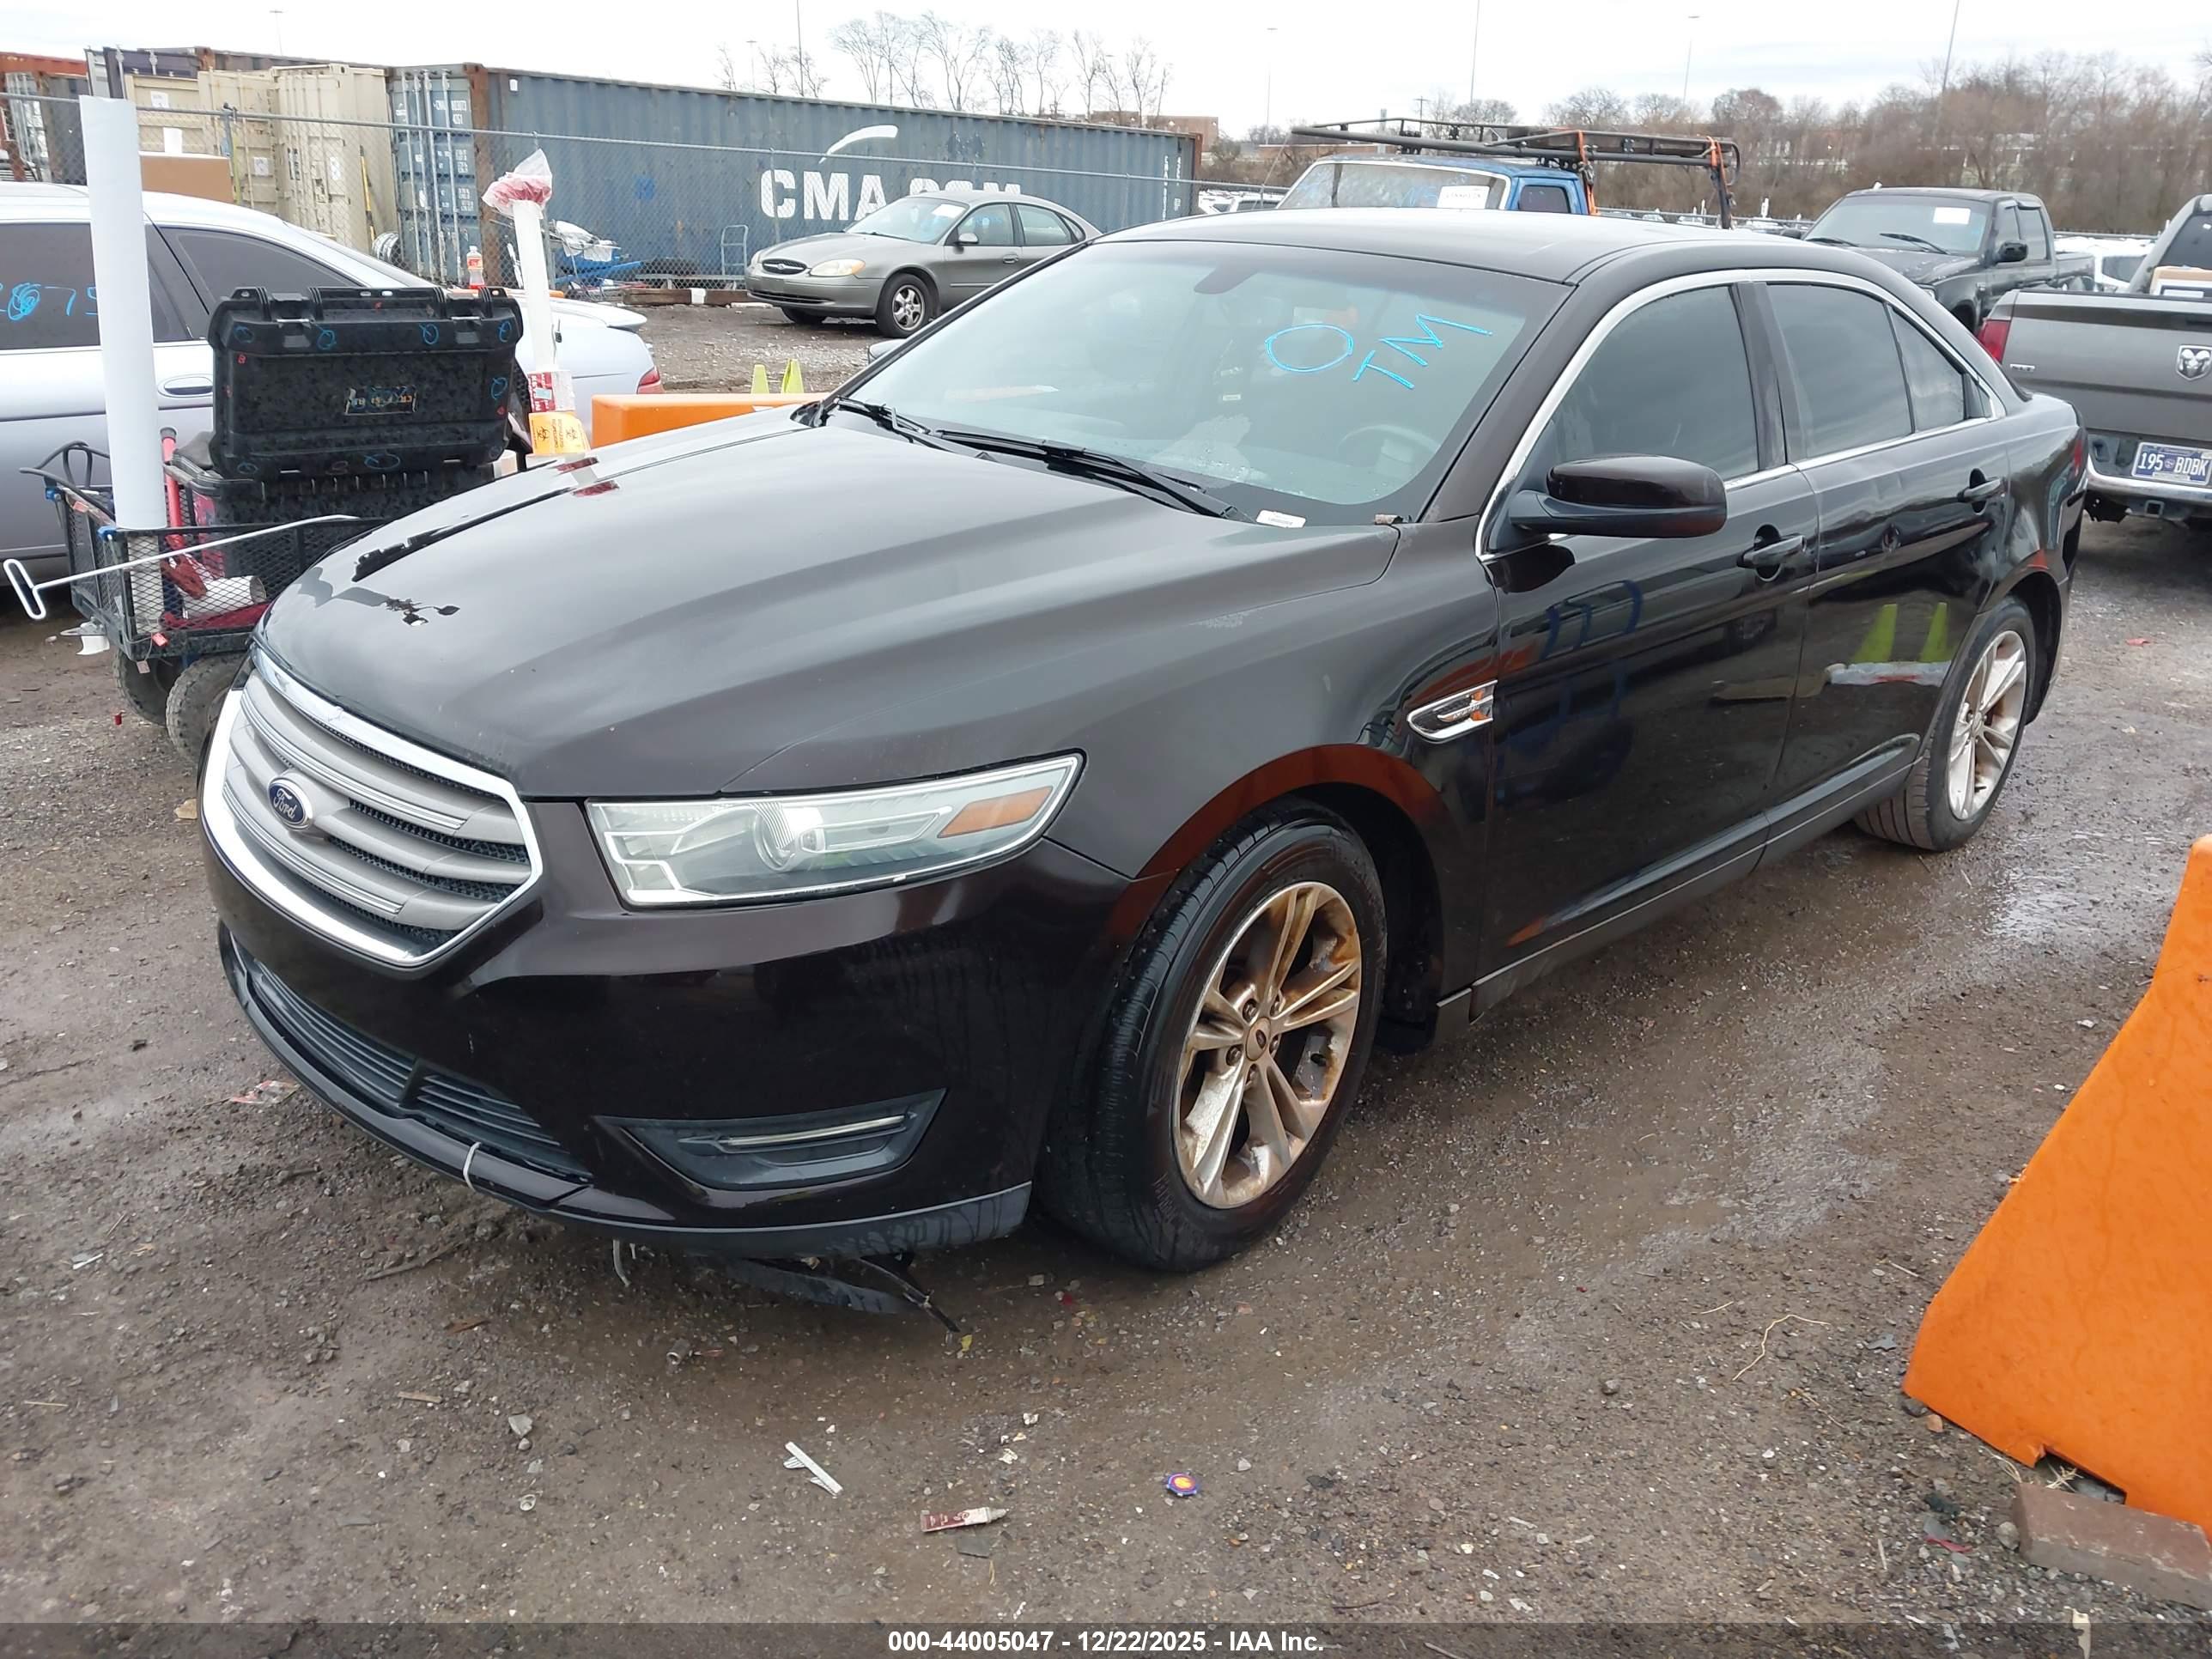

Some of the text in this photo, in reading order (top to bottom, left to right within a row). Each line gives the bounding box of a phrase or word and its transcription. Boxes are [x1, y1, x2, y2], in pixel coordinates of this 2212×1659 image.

[760, 169, 887, 221] CMA
[2137, 452, 2165, 471] 195
[273, 787, 297, 819] Ford
